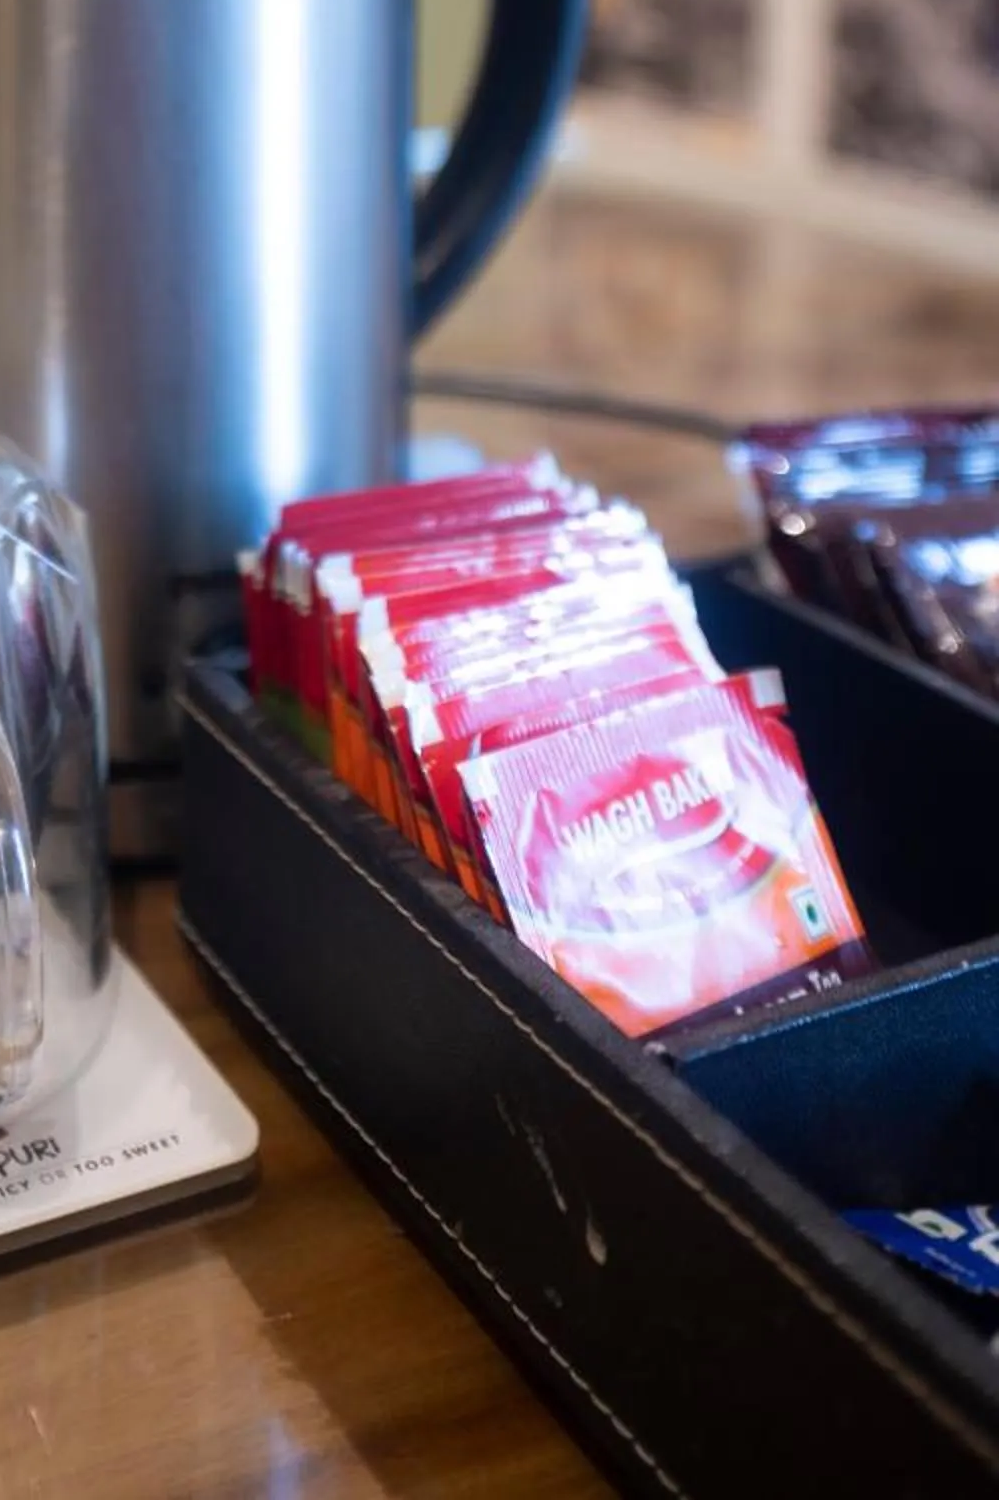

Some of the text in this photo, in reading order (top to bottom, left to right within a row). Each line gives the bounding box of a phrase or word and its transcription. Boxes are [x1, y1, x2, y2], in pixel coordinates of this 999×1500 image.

[560, 762, 729, 857] WAGH BAK
[39, 1171, 69, 1186] OR
[73, 1156, 115, 1175] TOO
[121, 1134, 181, 1161] SWEET
